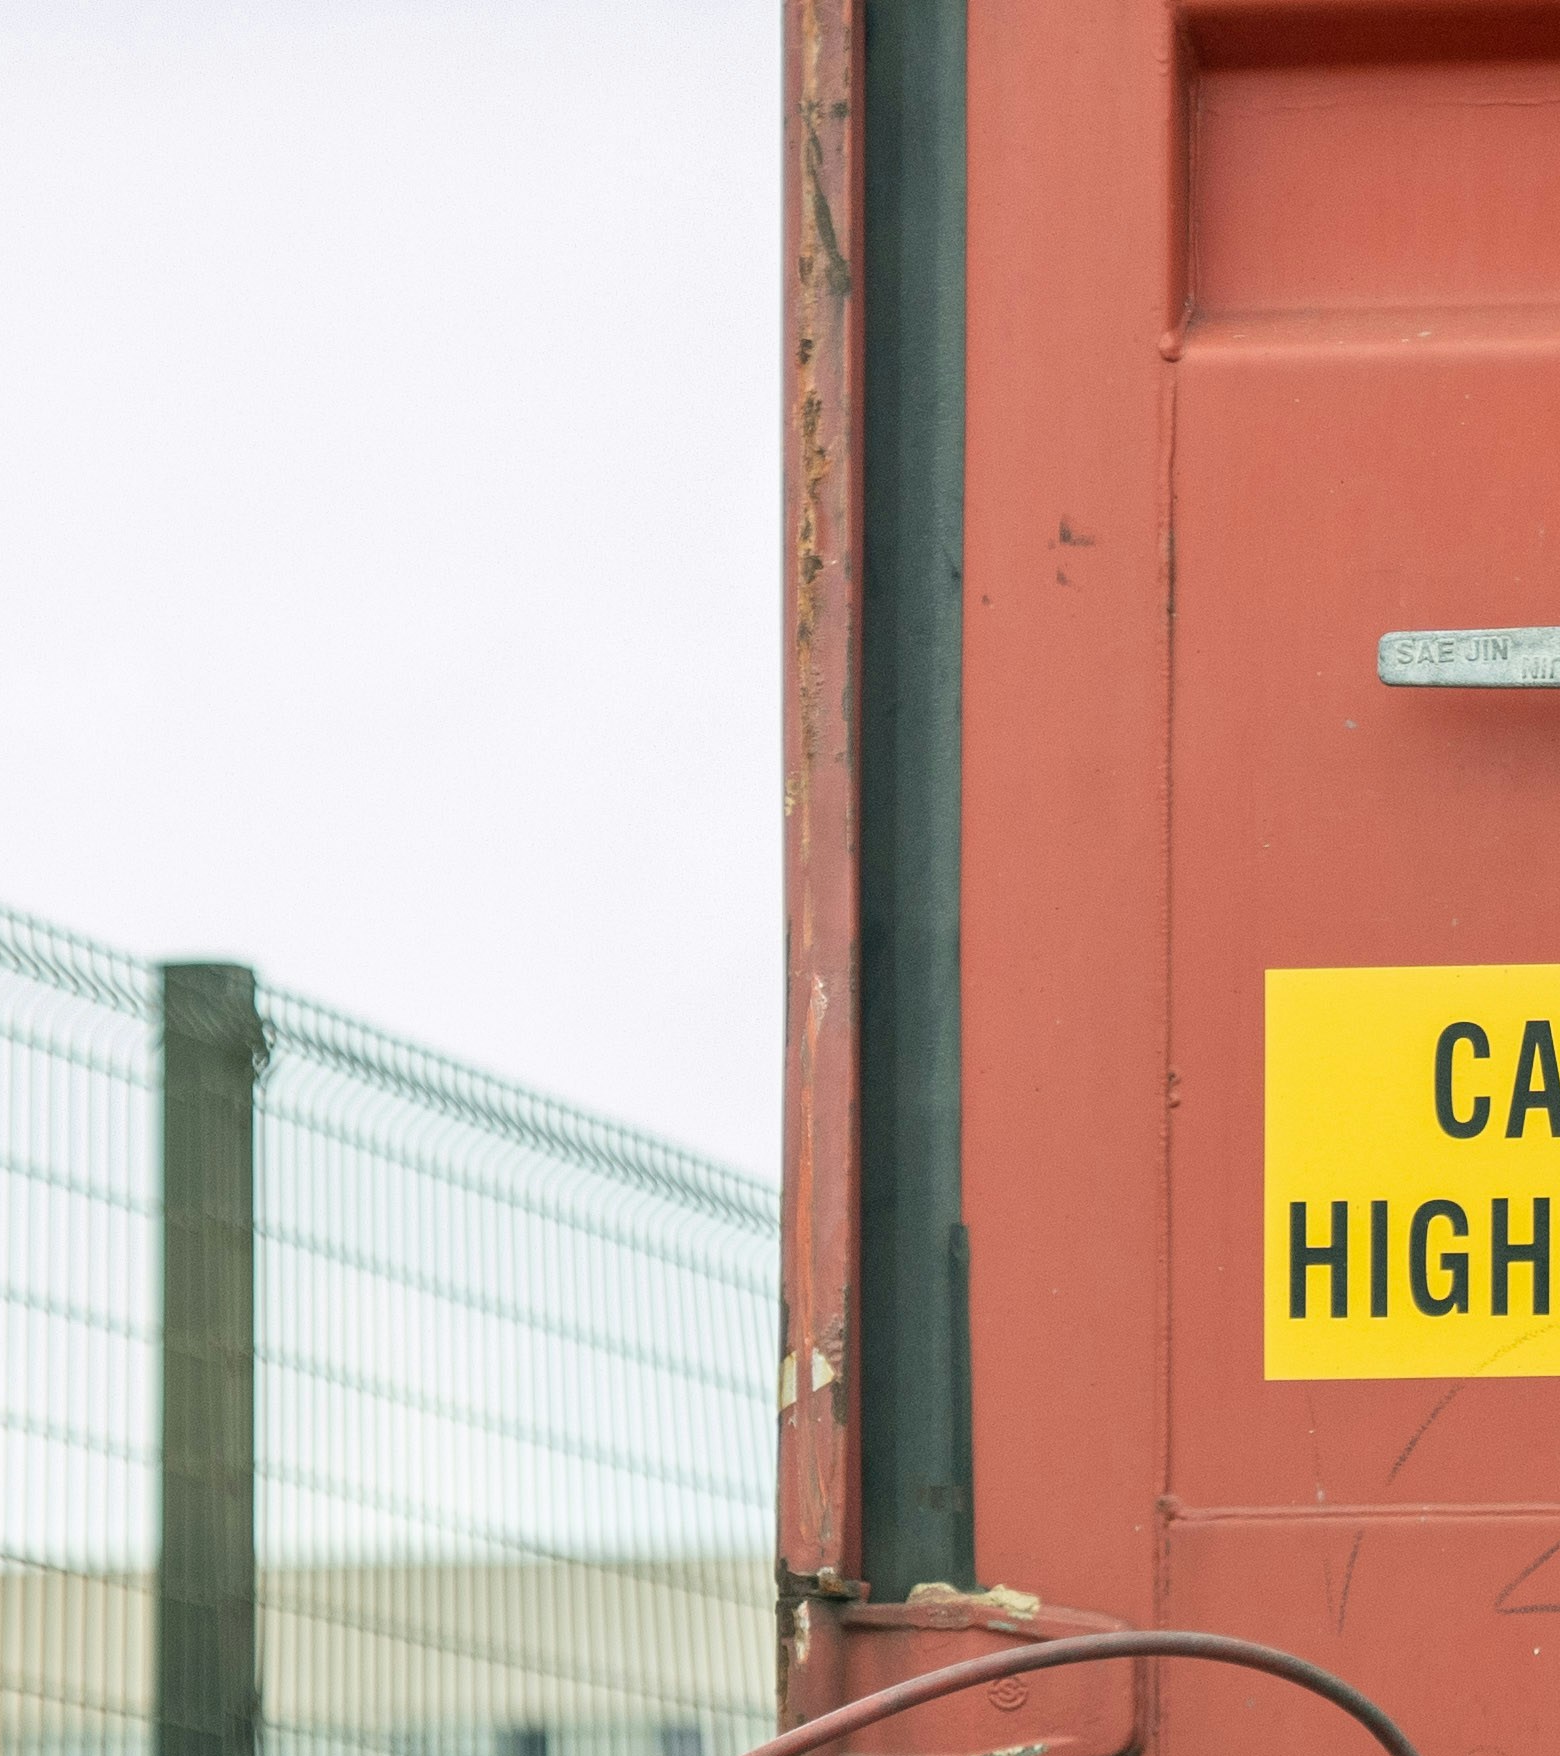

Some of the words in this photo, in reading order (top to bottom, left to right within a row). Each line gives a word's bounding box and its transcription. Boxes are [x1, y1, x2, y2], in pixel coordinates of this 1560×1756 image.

[1396, 637, 1455, 664] SAE
[1465, 636, 1509, 662] JIN
[1288, 1197, 1552, 1320] HIGH
